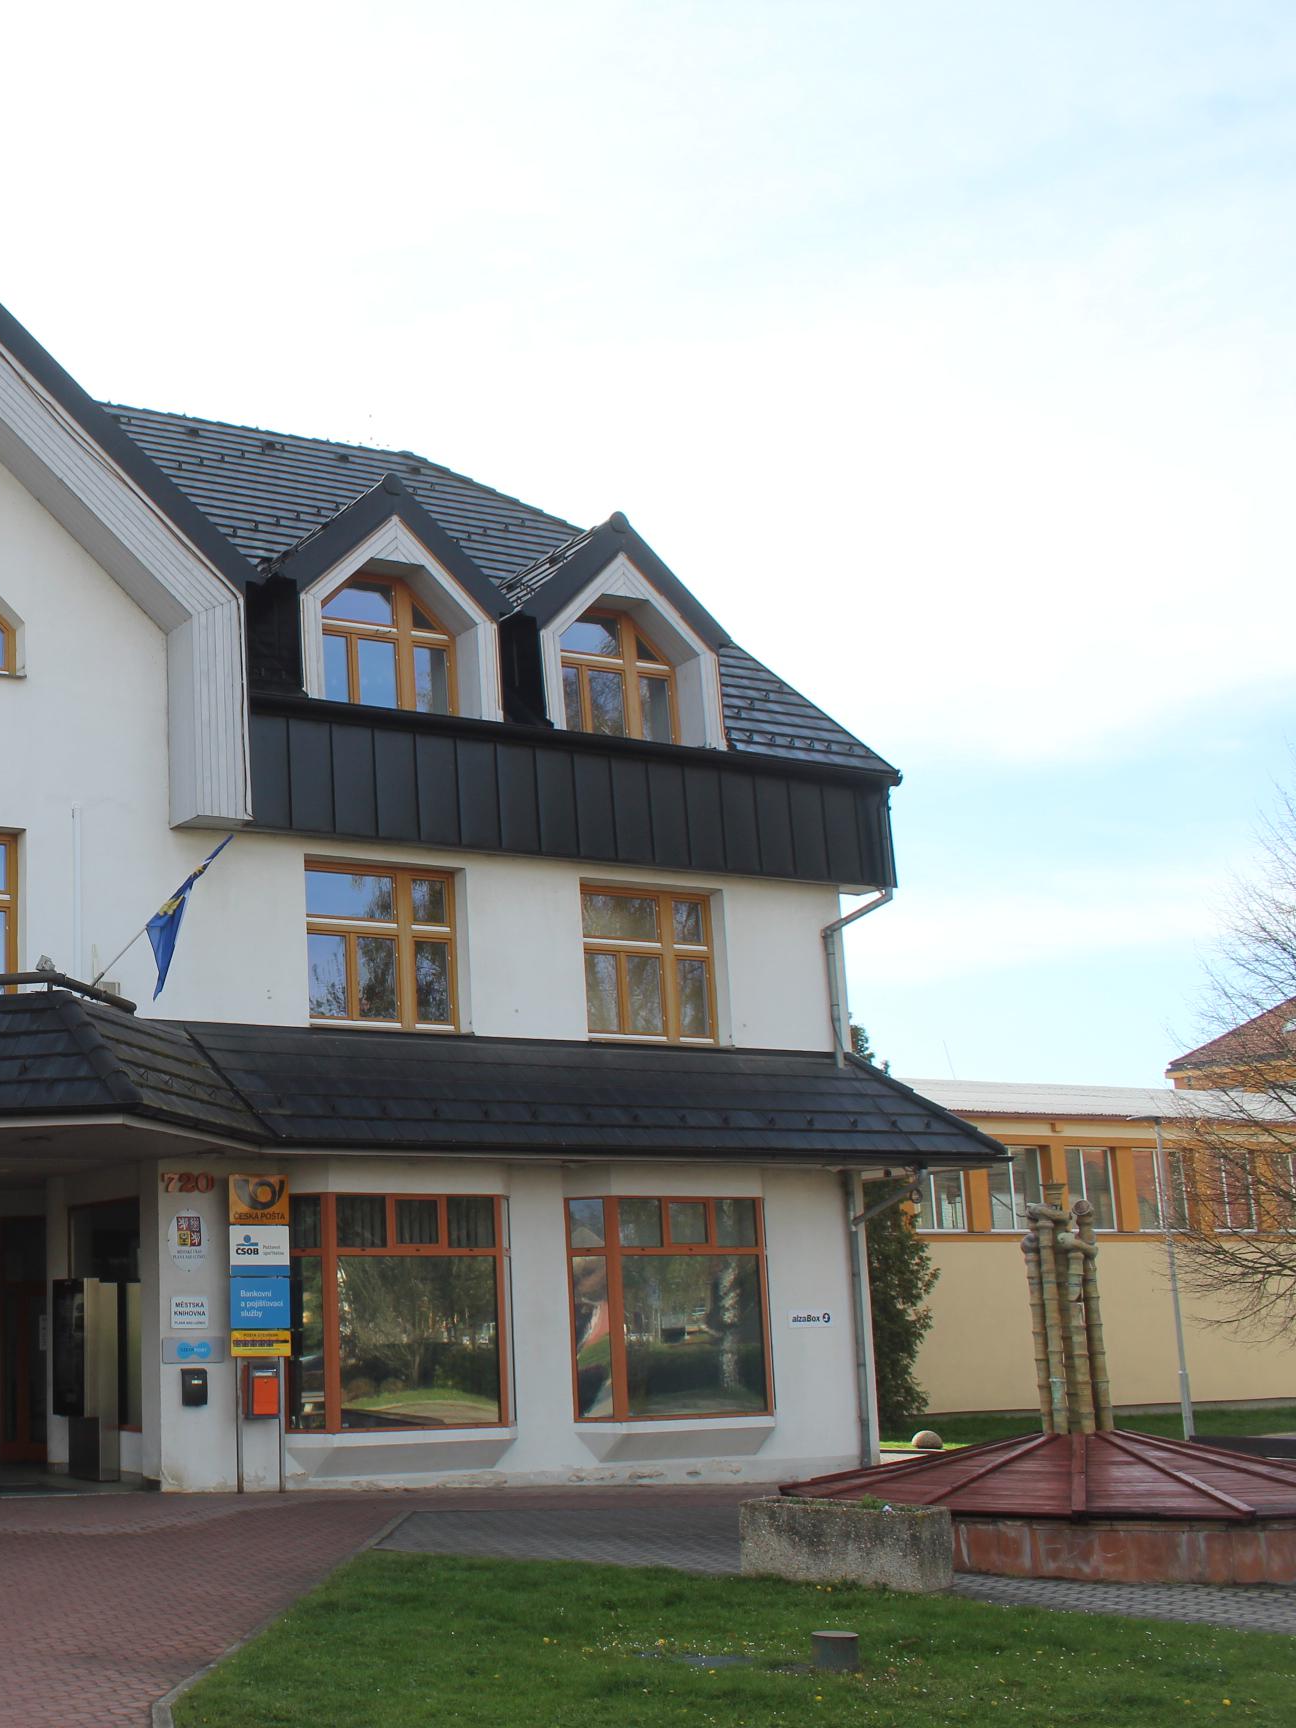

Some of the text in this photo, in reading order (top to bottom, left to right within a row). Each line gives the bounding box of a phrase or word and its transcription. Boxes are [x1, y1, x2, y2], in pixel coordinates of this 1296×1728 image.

[161, 1172, 214, 1193] 720
[233, 1210, 286, 1220] ČESKÁ POŠTA
[240, 1289, 272, 1297] Bankovní
[175, 1300, 205, 1308] MĚSTSKÁ
[240, 1309, 263, 1318] služby
[791, 1314, 821, 1323] alzaBox
